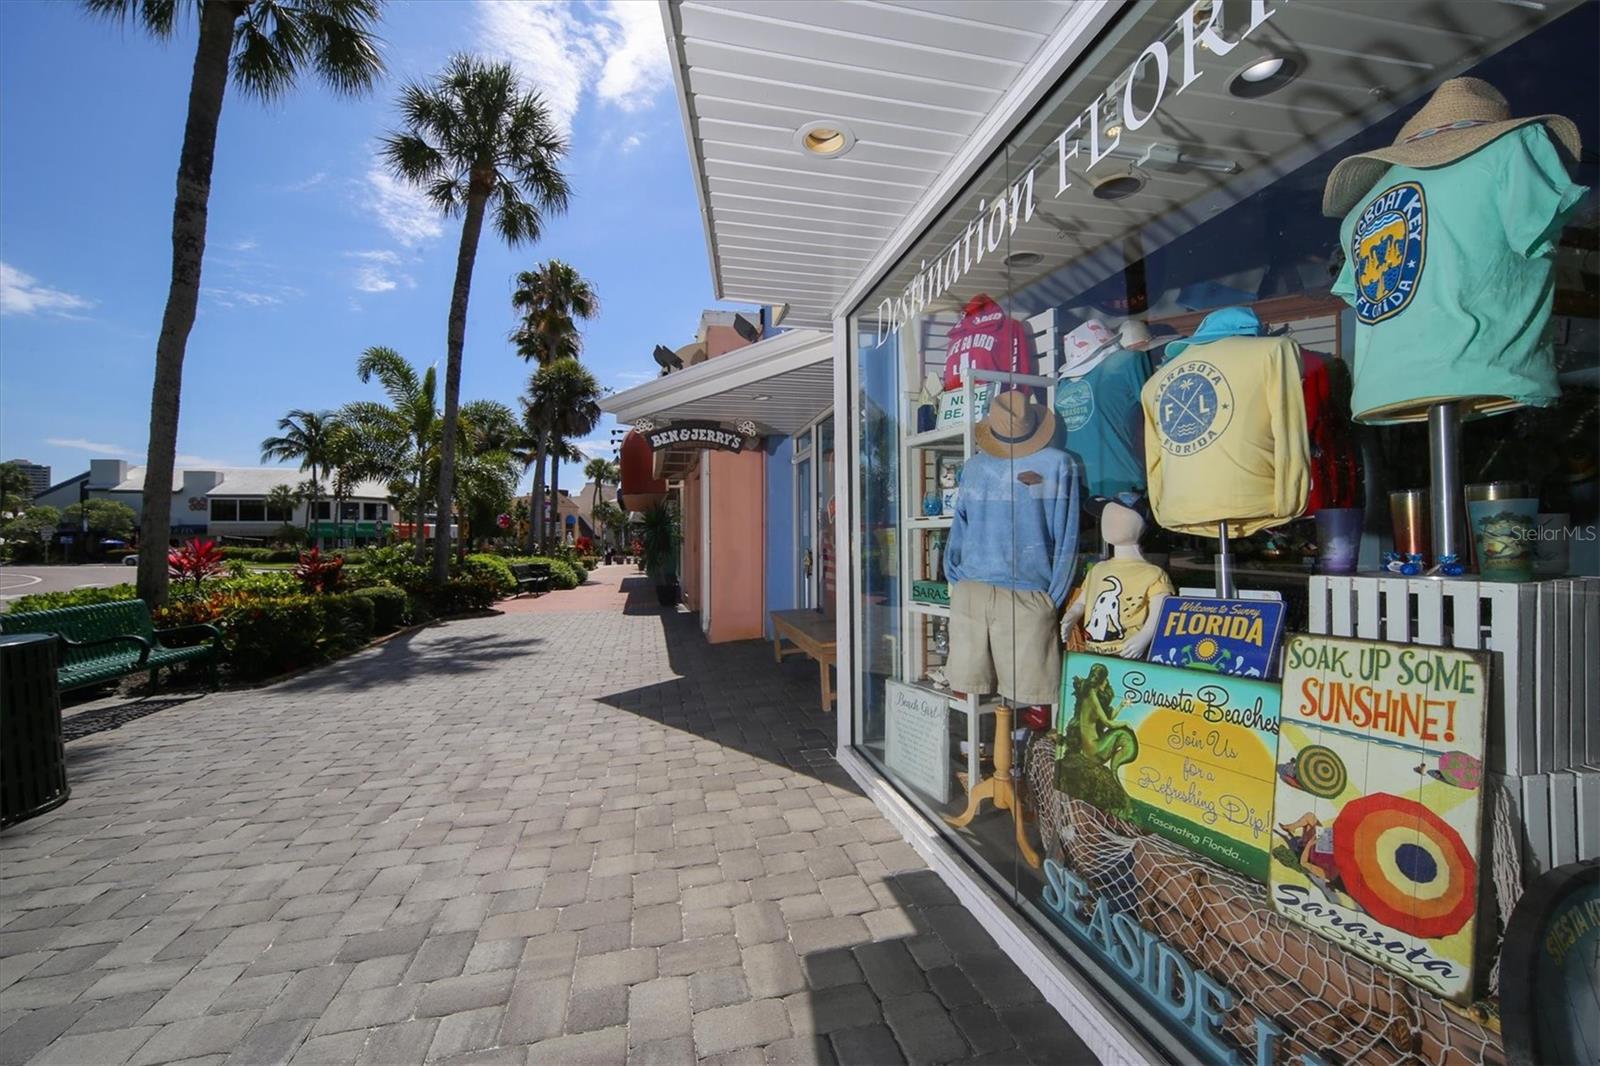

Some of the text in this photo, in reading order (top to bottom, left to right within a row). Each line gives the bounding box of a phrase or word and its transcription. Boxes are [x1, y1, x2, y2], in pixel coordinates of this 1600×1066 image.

[1403, 193, 1422, 241] KEY
[876, 168, 1036, 349] Destination
[944, 404, 990, 420] BECH
[1164, 394, 1210, 422] F L
[1163, 430, 1218, 453] FLORIDA
[1163, 612, 1263, 647] FLORIDA
[1179, 601, 1261, 619] Welcome to Sunny
[1289, 639, 1475, 694] SOAK UP SOME
[1122, 671, 1280, 735] Sarasota Beaches
[1300, 677, 1457, 742] SUNSHINE!
[1168, 722, 1239, 759] Join Us
[1183, 756, 1216, 781] for a
[1137, 766, 1271, 839] Refreshing Dip!
[1147, 813, 1200, 845] Fascinating
[1276, 884, 1460, 979] Sarasota
[1282, 906, 1447, 992] FLORIDA
[1043, 858, 1242, 1066] SEASIDE
